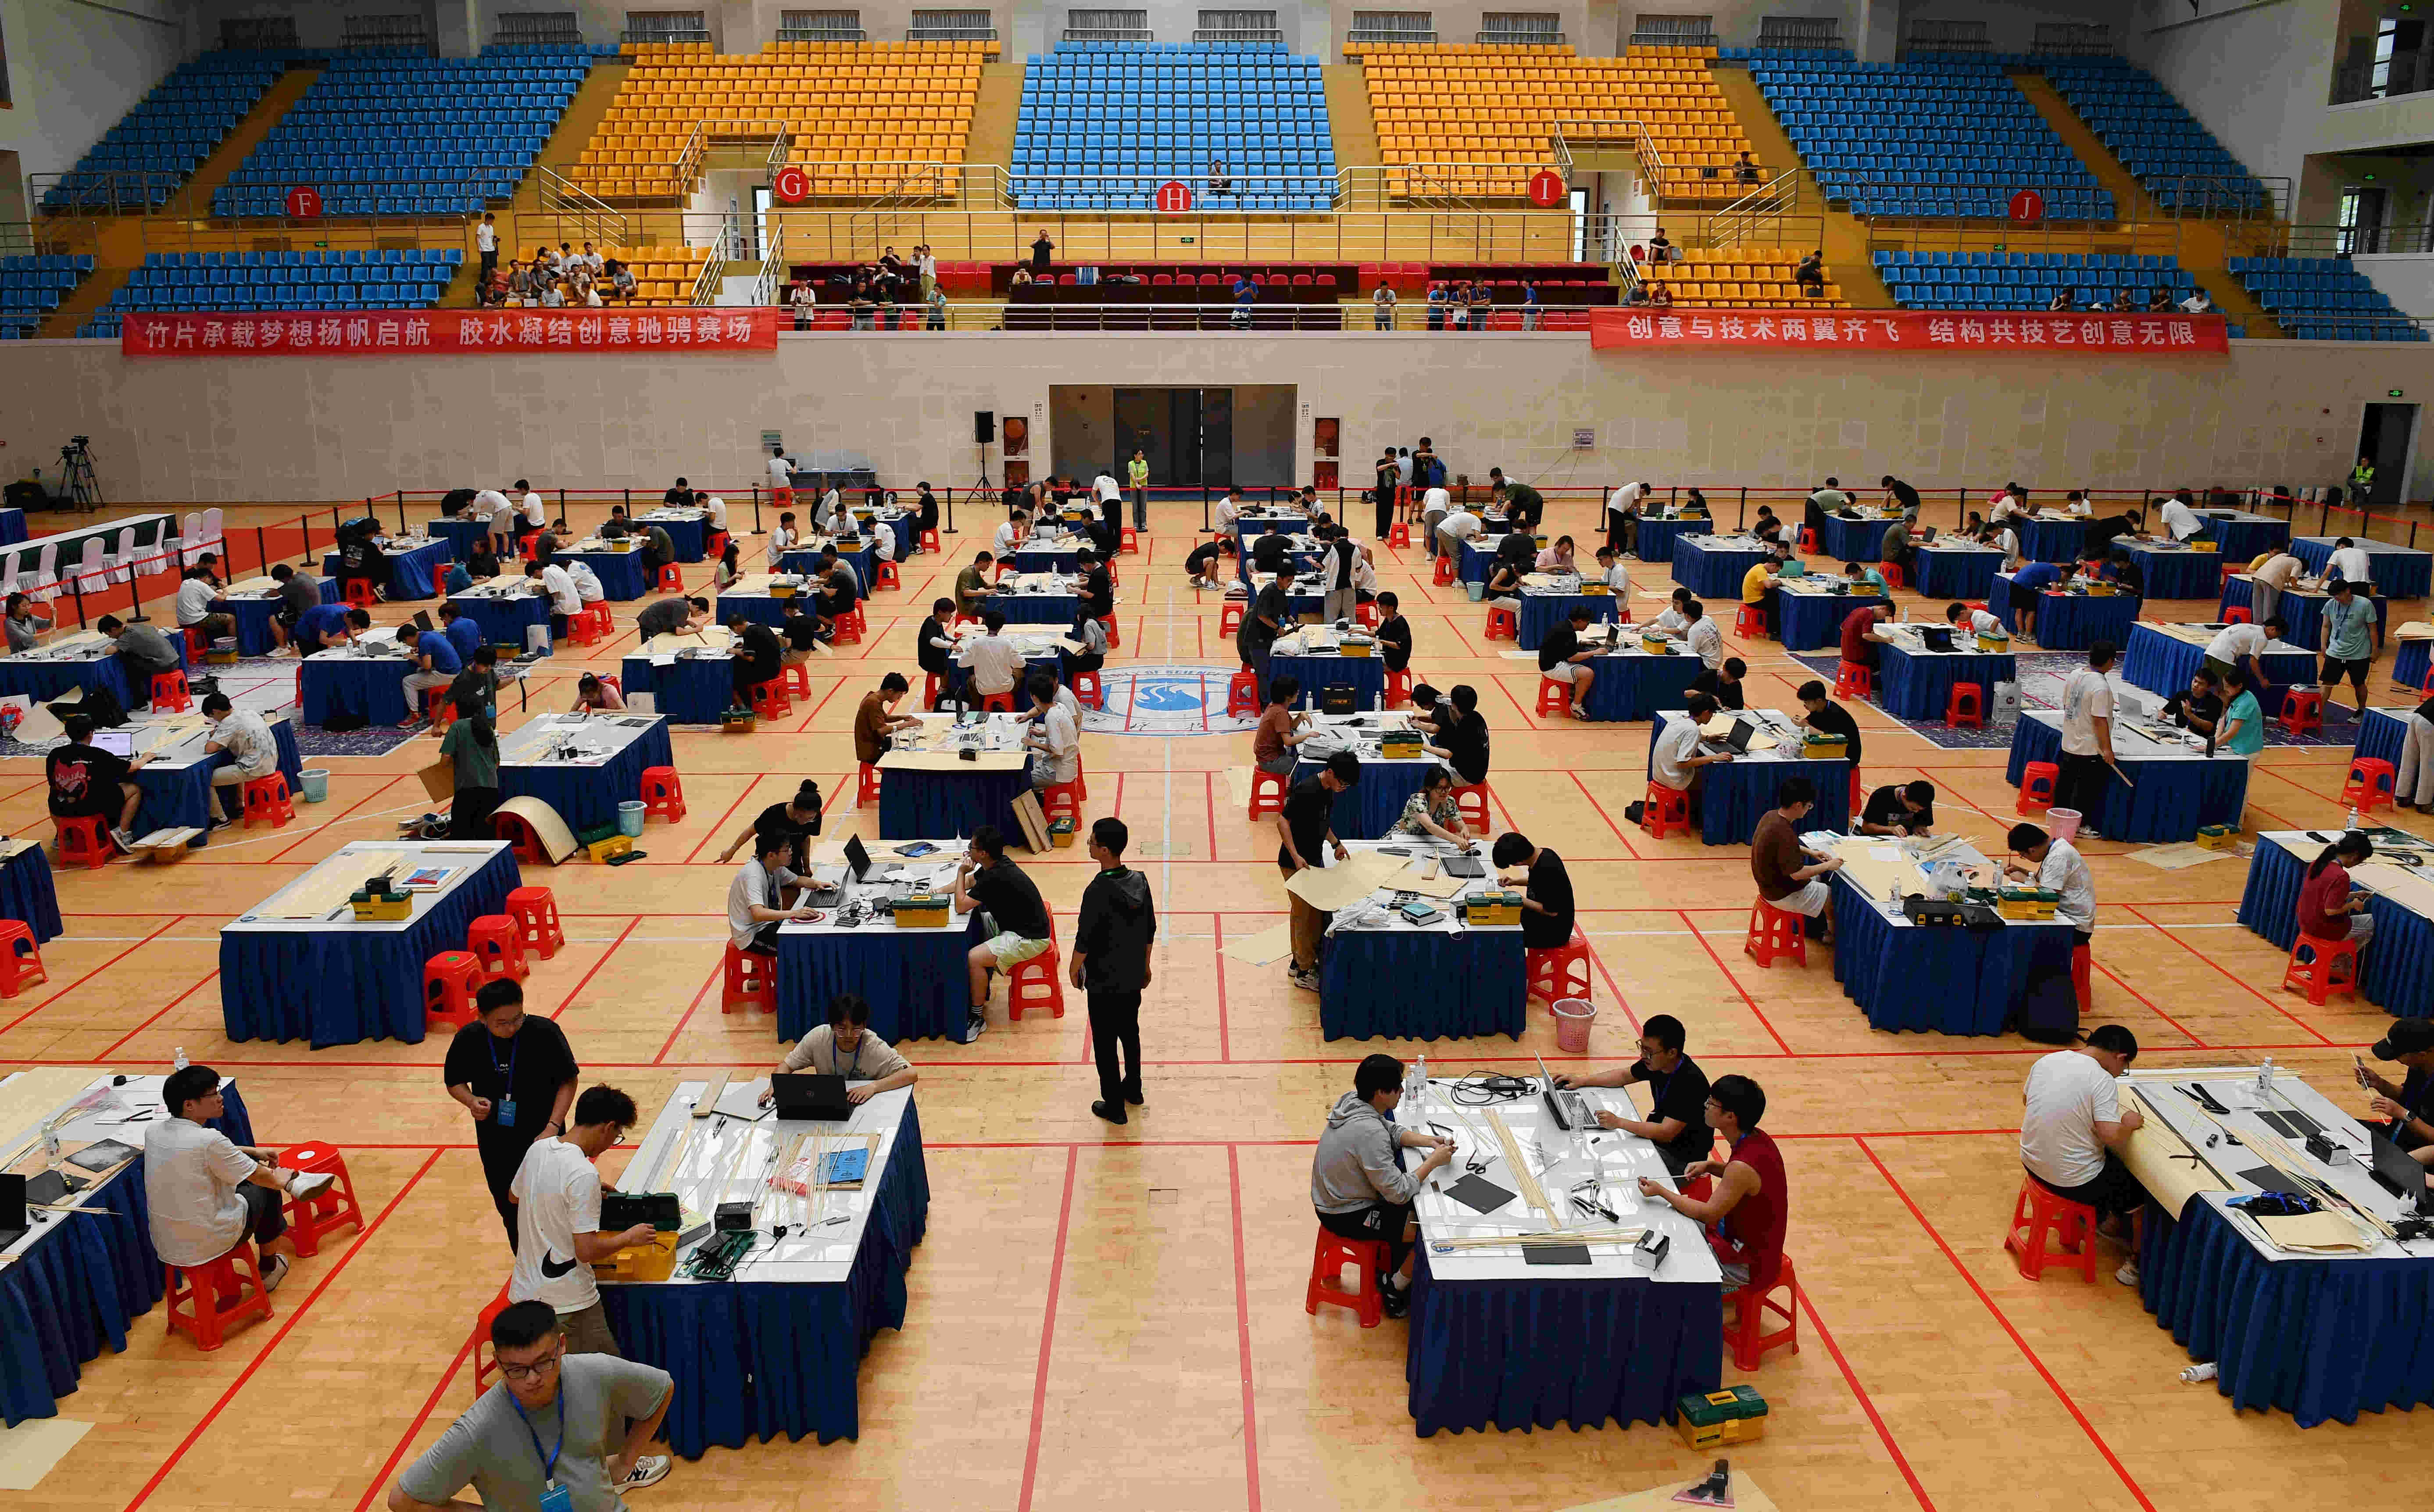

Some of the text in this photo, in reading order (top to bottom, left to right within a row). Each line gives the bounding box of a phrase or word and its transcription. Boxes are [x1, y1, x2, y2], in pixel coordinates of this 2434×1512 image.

[781, 174, 802, 196] G
[295, 193, 312, 215] F
[1164, 188, 1186, 210] H
[2019, 197, 2032, 218] J
[145, 316, 751, 348] 竹片承载梦想扬帆启航 胶水凝结创意驰骋赛场
[1626, 315, 2196, 345] 创意与技术两翼齐飞 结构共技艺创意无限
